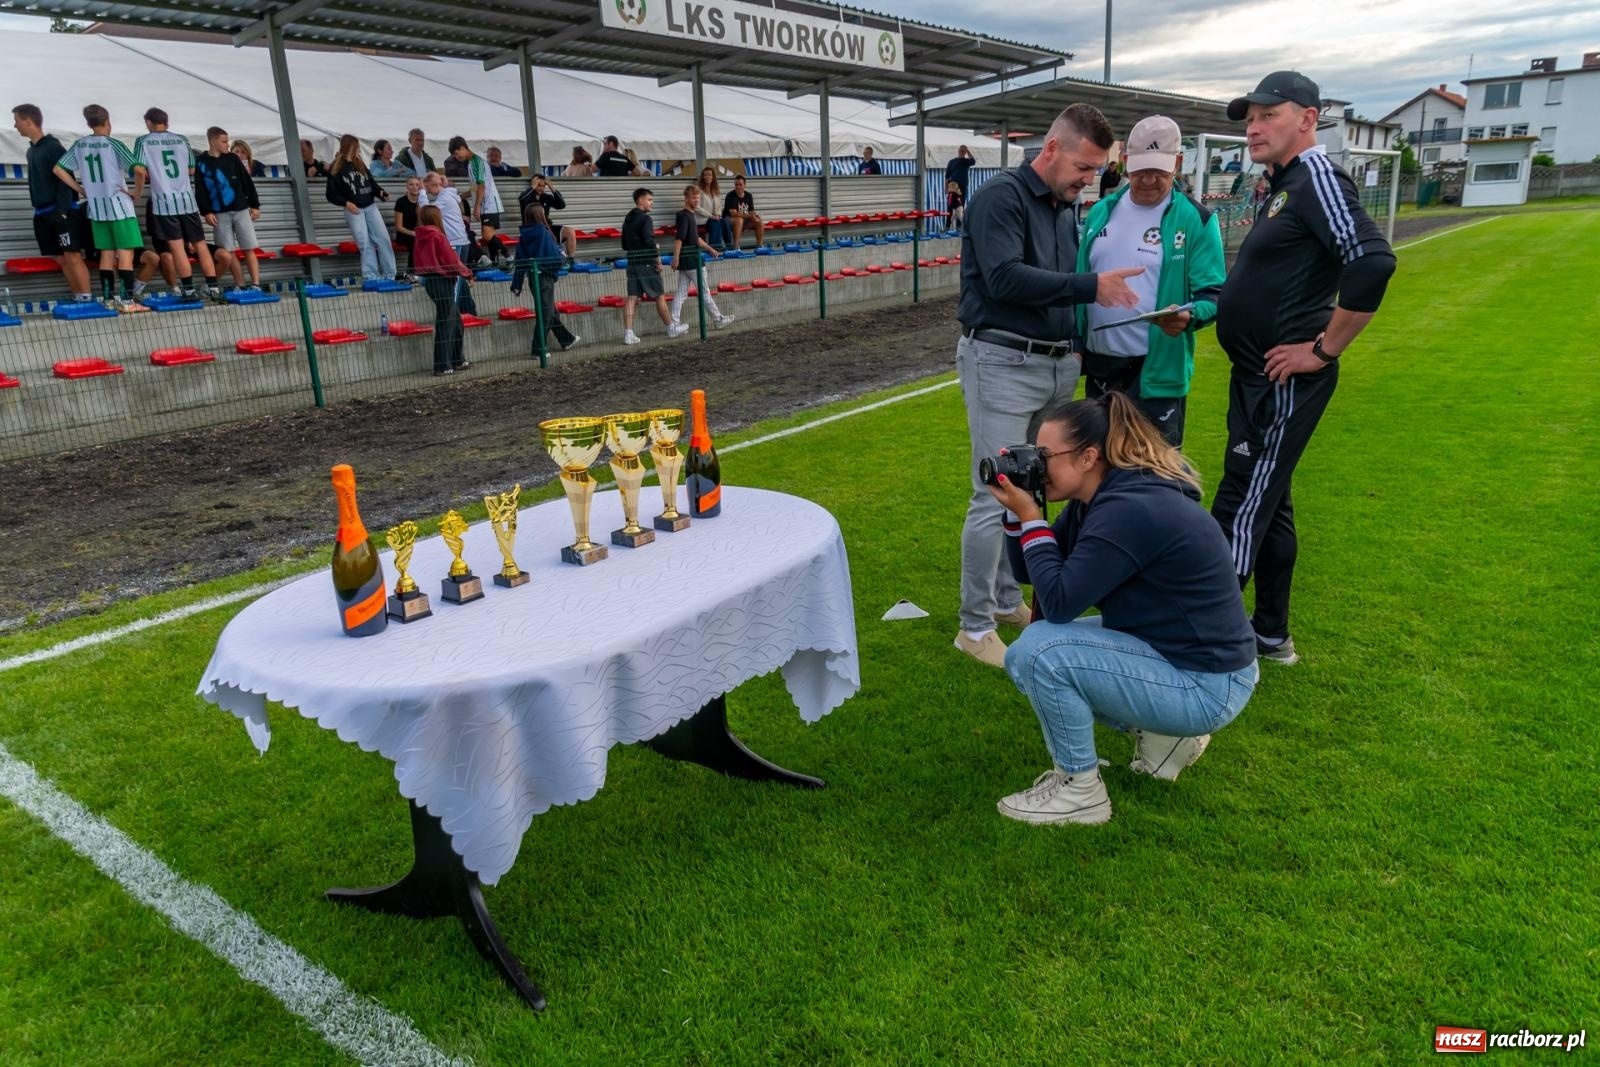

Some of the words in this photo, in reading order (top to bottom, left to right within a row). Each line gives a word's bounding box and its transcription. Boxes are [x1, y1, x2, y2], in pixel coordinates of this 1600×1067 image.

[665, 0, 726, 40] LKS
[734, 11, 866, 62] TWORKÓW
[84, 153, 105, 183] 11
[161, 150, 180, 179] 5
